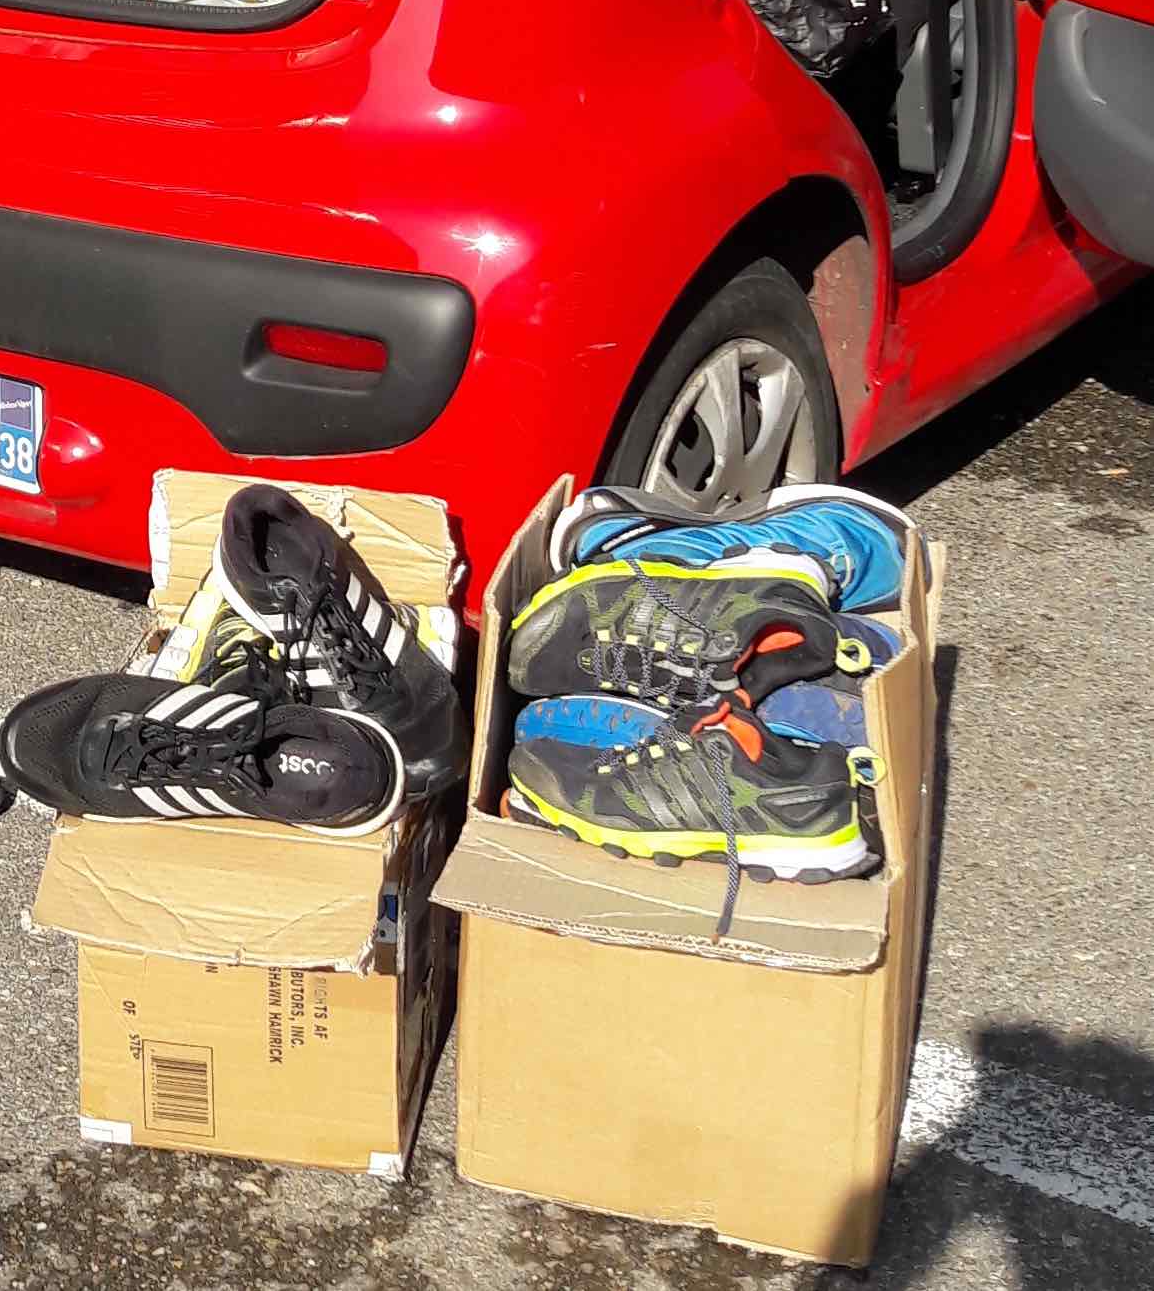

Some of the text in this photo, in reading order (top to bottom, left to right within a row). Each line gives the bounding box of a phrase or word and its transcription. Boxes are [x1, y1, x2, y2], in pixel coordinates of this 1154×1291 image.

[0, 431, 33, 475] 38
[268, 966, 283, 1064] SHAWN HAMRICK
[290, 1026, 305, 1049] INC.
